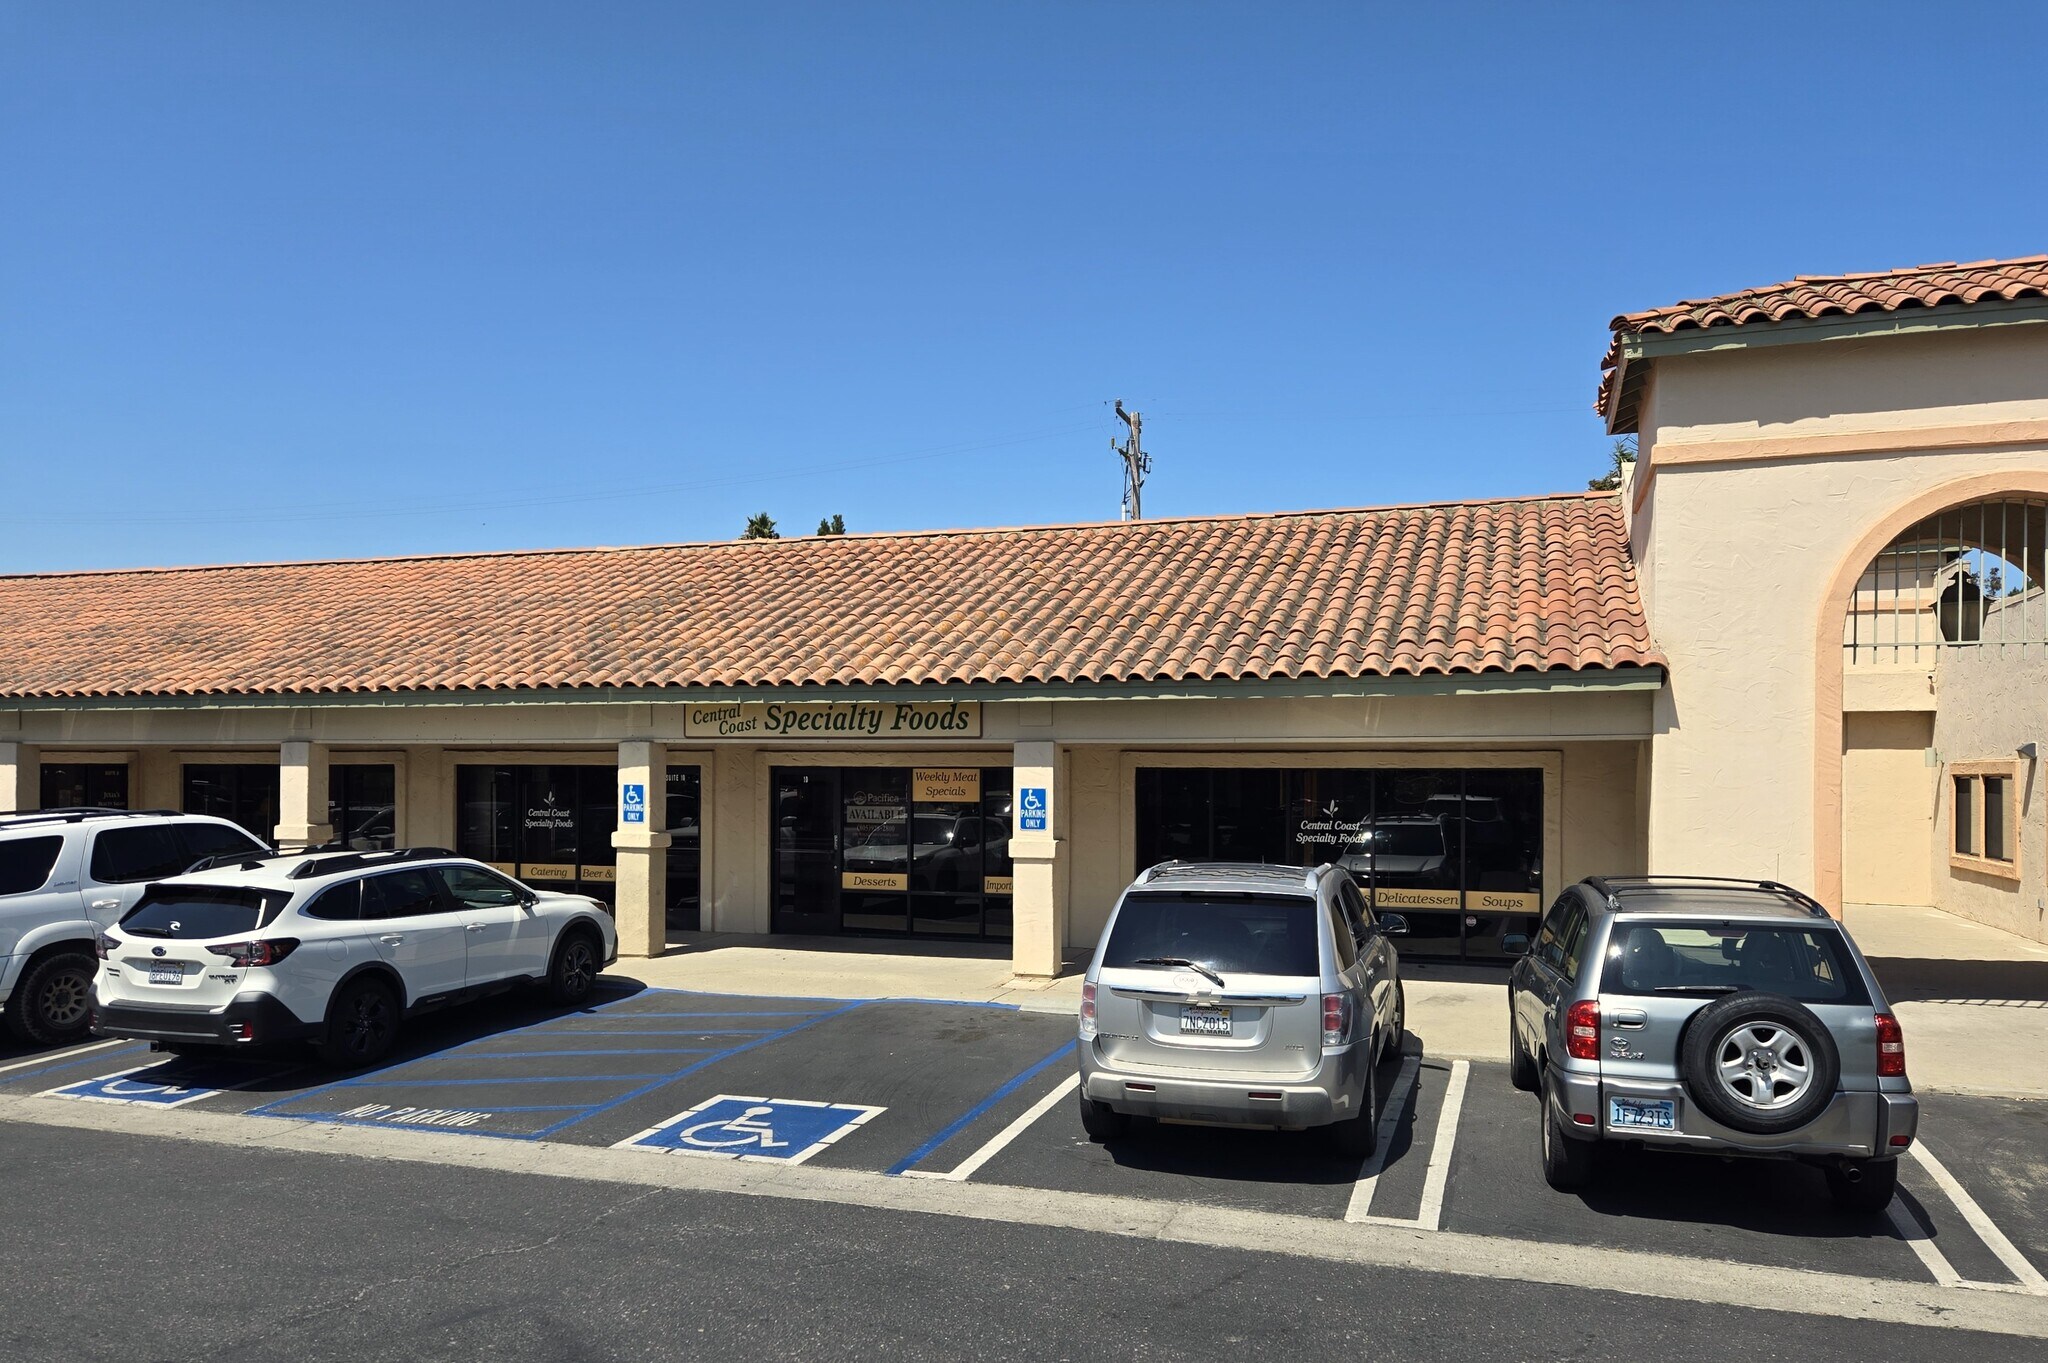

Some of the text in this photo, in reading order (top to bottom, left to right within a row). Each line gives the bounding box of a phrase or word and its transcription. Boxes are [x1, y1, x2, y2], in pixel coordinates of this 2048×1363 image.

[693, 703, 741, 725] Central
[764, 703, 970, 734] Specialty Foods
[719, 716, 757, 735] Coast
[915, 771, 977, 784] Weekly Meat
[867, 793, 899, 803] Pacifica
[925, 786, 966, 798] Specials
[528, 808, 570, 817] Central Coast
[623, 804, 643, 812] PARKING
[849, 808, 904, 820] AVAILABLE
[1020, 809, 1046, 818] PARKING
[627, 812, 640, 821] ONLY
[525, 819, 574, 829] Specialty Foods
[1025, 819, 1041, 828] ONLY
[1300, 820, 1360, 831] Central Coast
[1296, 832, 1366, 845] Specialty Foods
[530, 867, 567, 878] Catering
[582, 869, 614, 879] Beer &
[853, 876, 897, 887] Desserts
[986, 880, 1013, 893] Import
[1377, 892, 1459, 905] Delicatessen
[1481, 896, 1523, 912] Soups
[1183, 1016, 1229, 1031] 7NCZ015
[338, 1103, 492, 1127] NO PARKING
